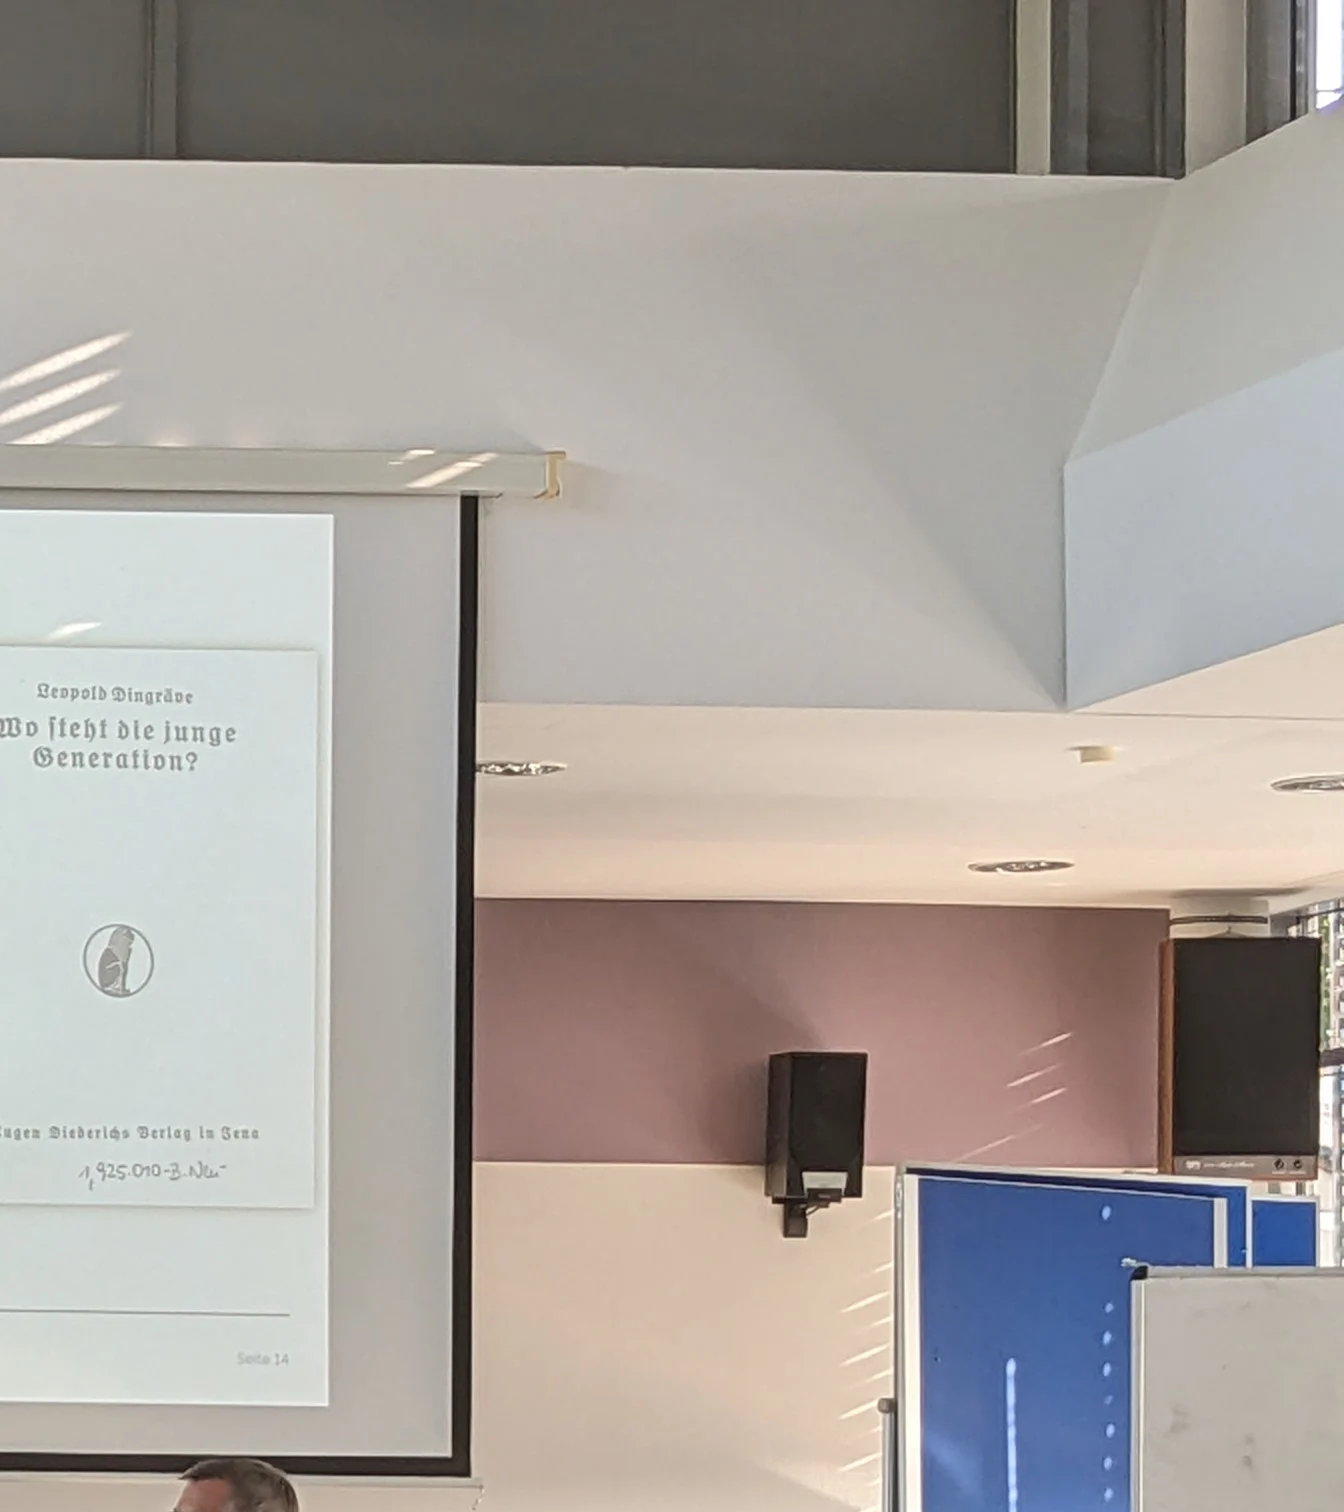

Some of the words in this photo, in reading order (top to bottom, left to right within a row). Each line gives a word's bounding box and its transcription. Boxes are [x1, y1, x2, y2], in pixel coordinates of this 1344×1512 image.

[116, 719, 155, 741] die
[163, 720, 237, 747] junge
[32, 745, 198, 771] Generation?
[274, 1352, 290, 1366] 14
